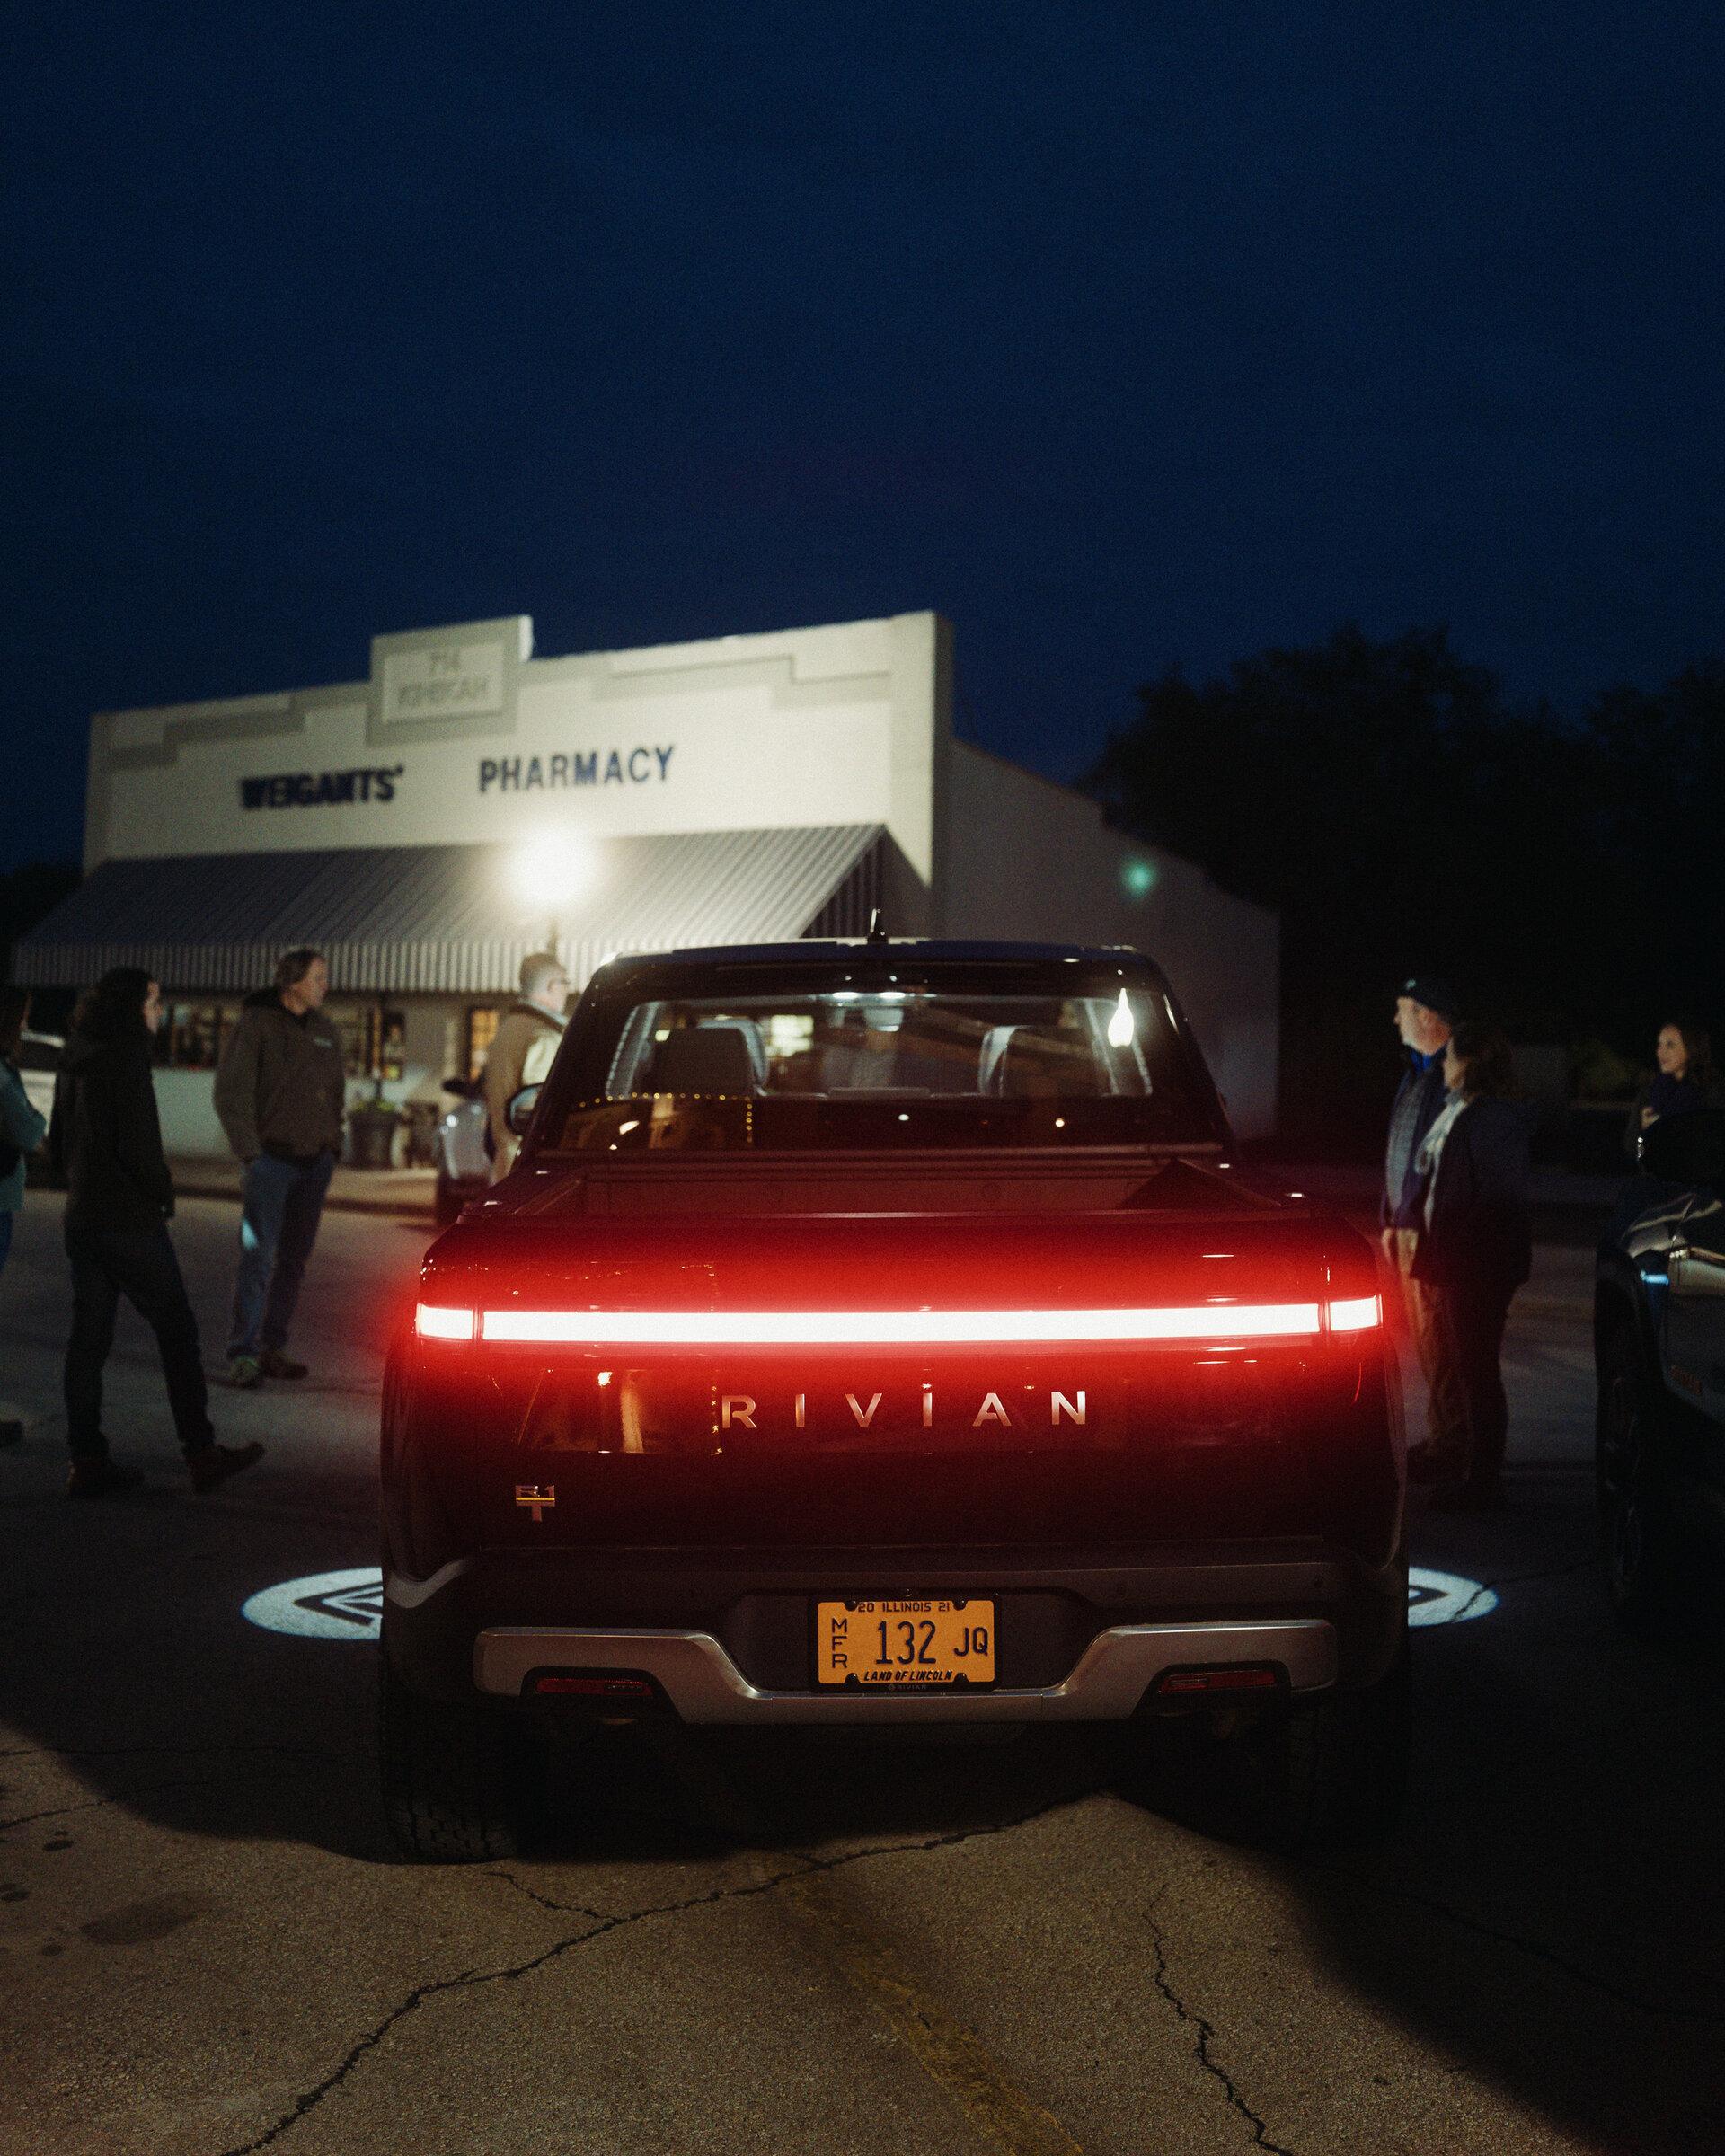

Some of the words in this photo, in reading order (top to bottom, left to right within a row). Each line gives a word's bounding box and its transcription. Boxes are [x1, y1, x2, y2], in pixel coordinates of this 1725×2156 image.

[479, 745, 675, 793] PHARMACY
[721, 1391, 1086, 1429] RIVIAN
[858, 1602, 874, 1613] 20
[882, 1602, 932, 1613] ILLINOIS
[938, 1602, 950, 1612] 21
[875, 1620, 936, 1665] 132
[953, 1627, 988, 1656] JQ
[863, 1671, 891, 1682] LAND
[894, 1670, 907, 1681] OF
[909, 1670, 952, 1681] LINCOLN
